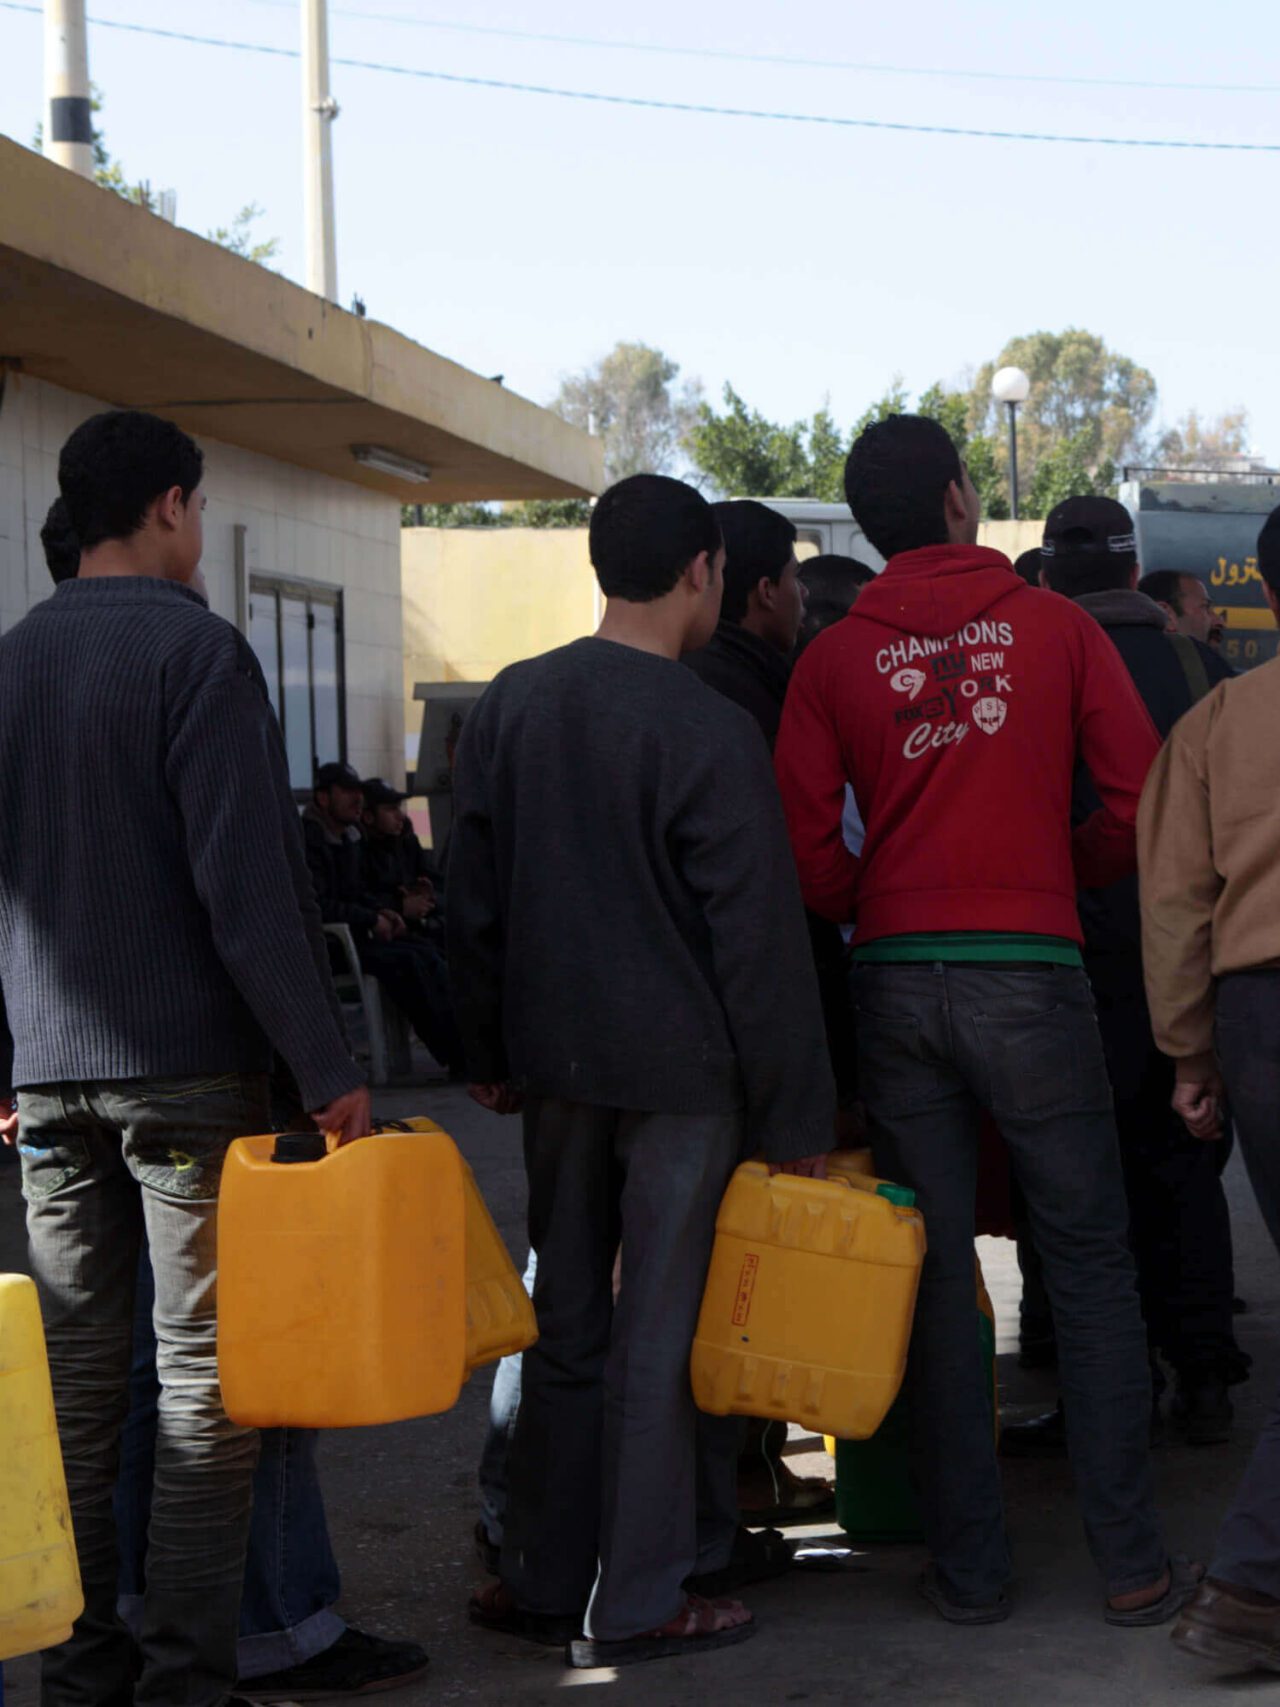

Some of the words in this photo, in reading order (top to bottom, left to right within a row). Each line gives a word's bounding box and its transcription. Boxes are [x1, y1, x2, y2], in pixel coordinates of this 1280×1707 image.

[970, 651, 1004, 673] NEW
[940, 674, 1013, 717] YORK
[902, 720, 970, 760] City
